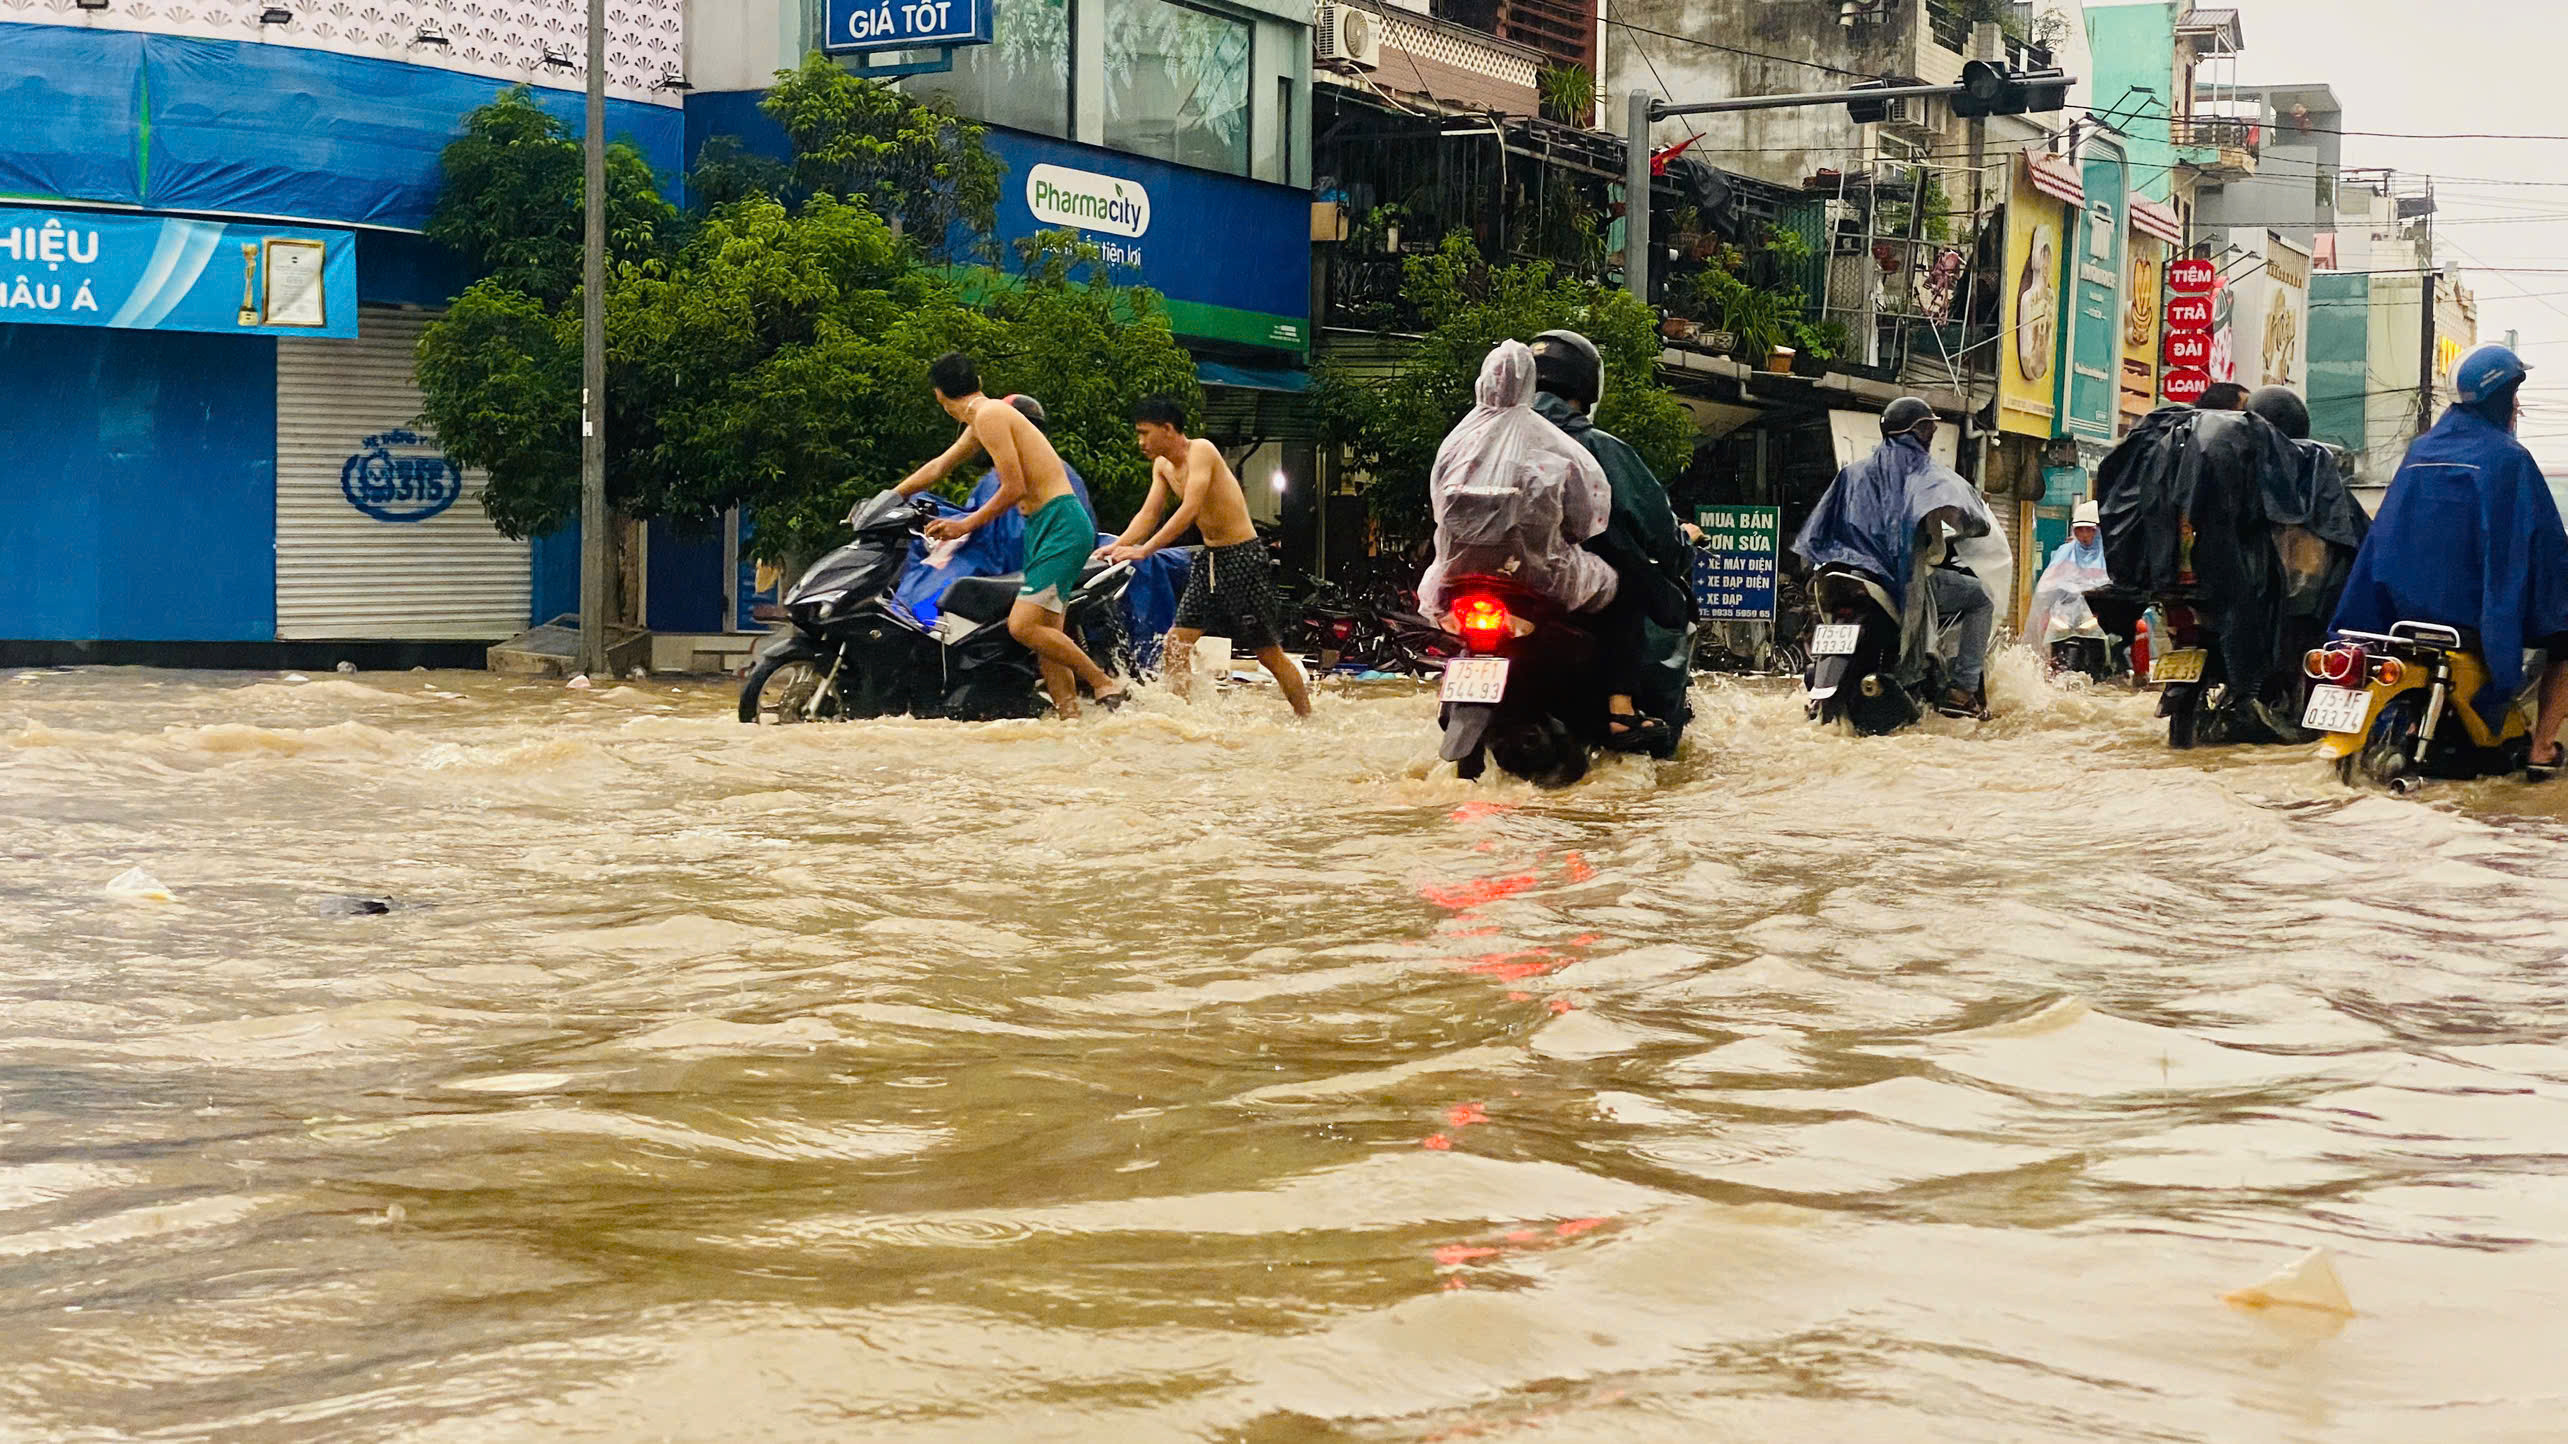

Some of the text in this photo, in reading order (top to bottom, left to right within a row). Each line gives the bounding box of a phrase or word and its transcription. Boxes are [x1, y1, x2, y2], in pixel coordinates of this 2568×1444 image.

[849, 0, 895, 39] GIÁ
[1035, 180, 1141, 233] Pharmacity
[2172, 265, 2211, 286] TIỆM
[71, 278, 98, 311] Á
[2173, 302, 2206, 320] TRÀ
[2173, 338, 2203, 356] ĐÀI
[2167, 379, 2205, 393] LOAN
[1700, 510, 1773, 529] MUA BÁN
[1739, 531, 1771, 551] SỬA
[1708, 556, 1772, 573] XE MÁY ĐIỆN
[1707, 574, 1770, 591] XE ĐẠP ĐIỆN
[1706, 593, 1743, 608] XE ĐẠP
